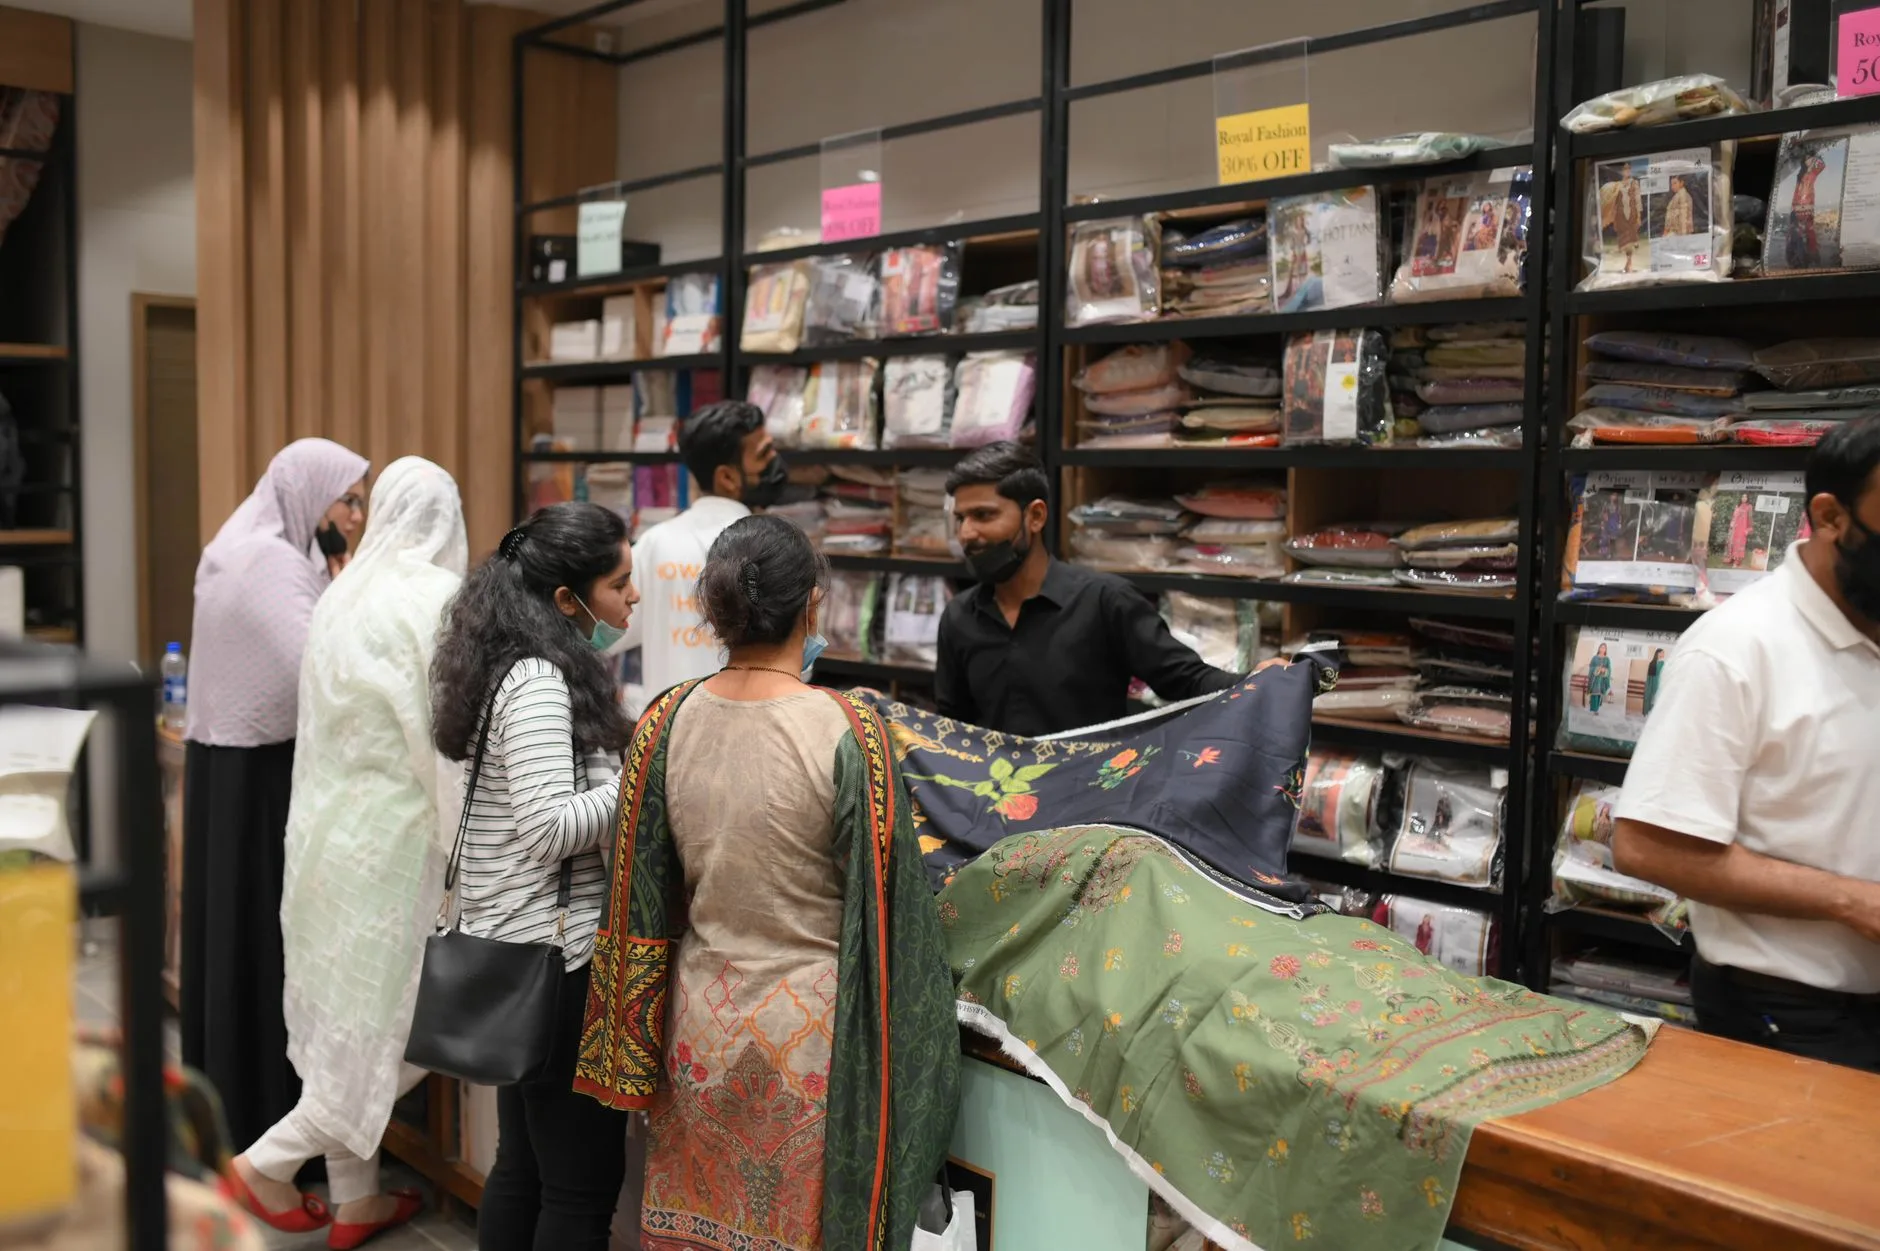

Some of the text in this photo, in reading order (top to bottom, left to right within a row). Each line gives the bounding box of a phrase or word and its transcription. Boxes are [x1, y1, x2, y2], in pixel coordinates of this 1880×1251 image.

[1219, 123, 1307, 146] Royal Fashion
[1221, 148, 1304, 176] 30% OFF
[1731, 472, 1768, 484] Orient
